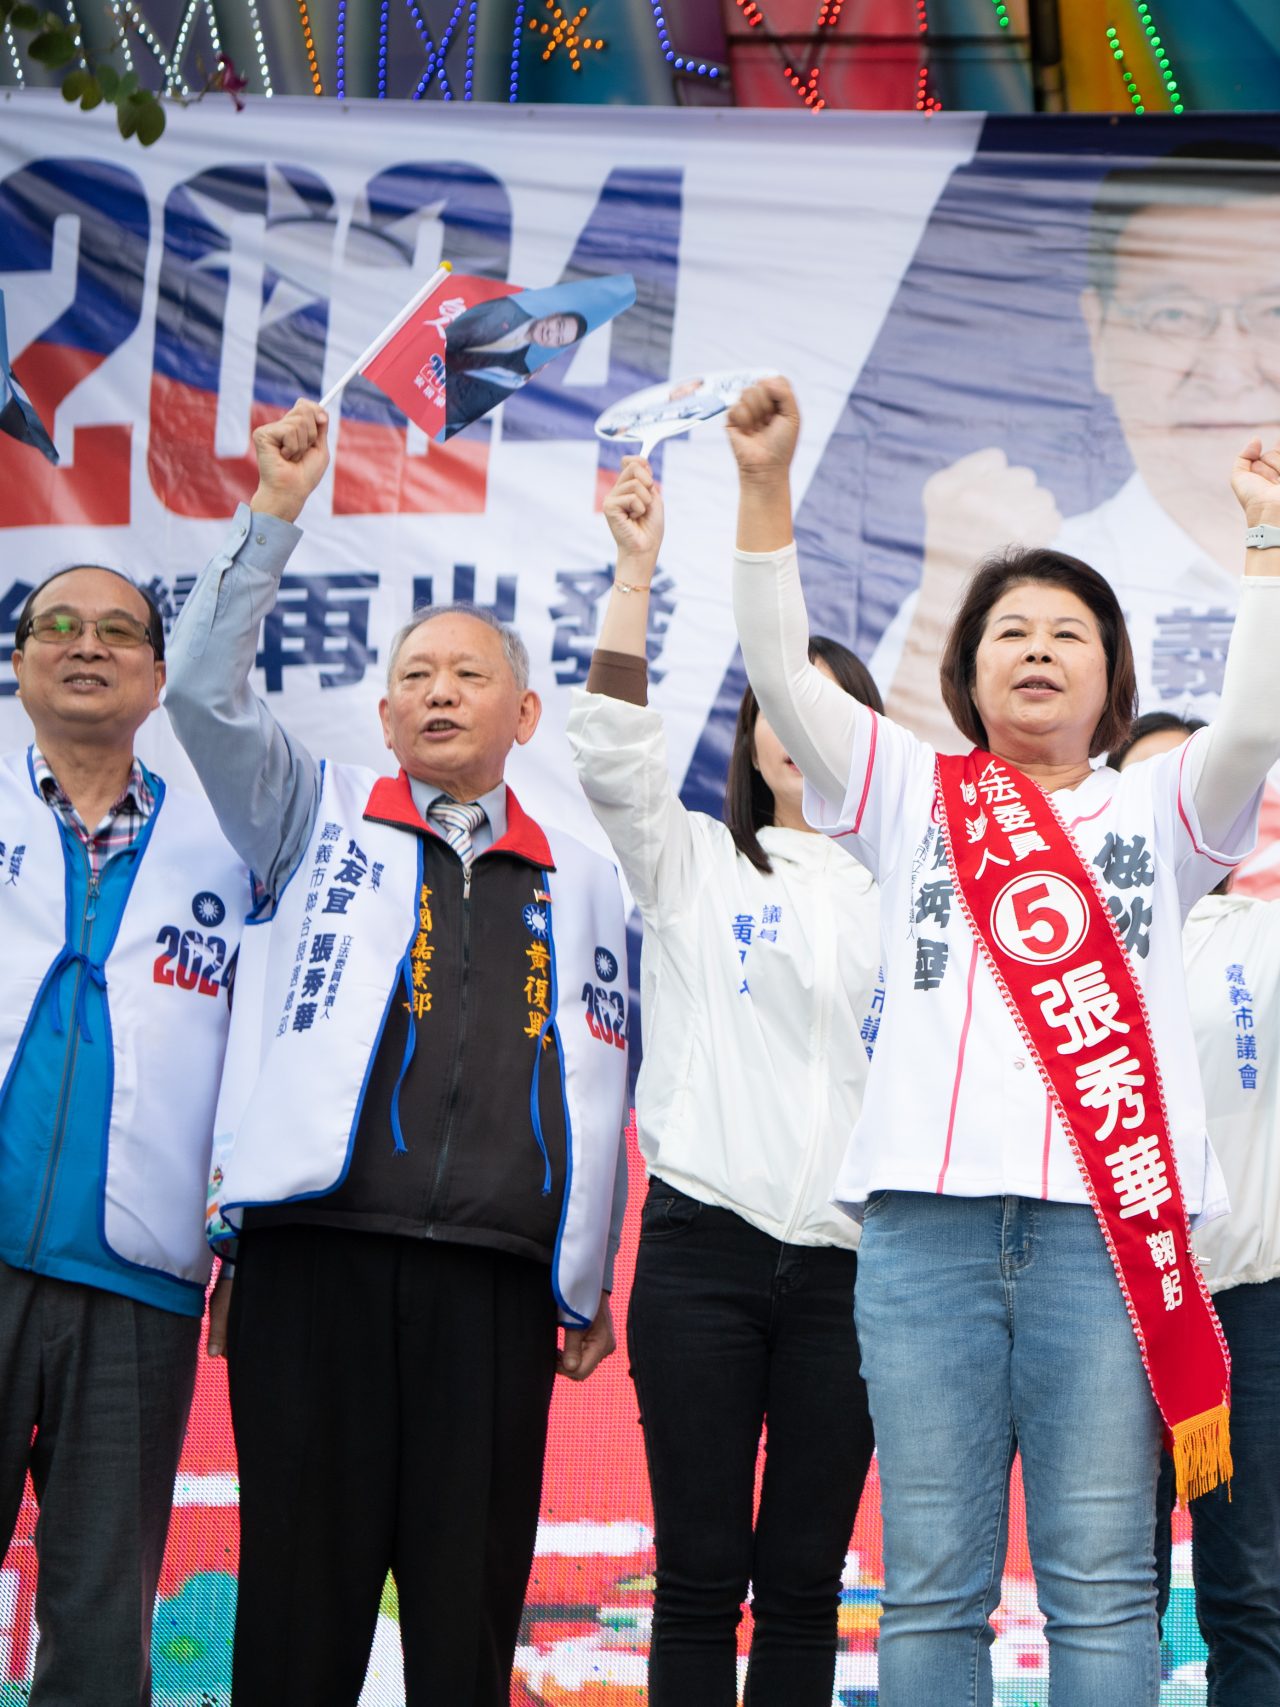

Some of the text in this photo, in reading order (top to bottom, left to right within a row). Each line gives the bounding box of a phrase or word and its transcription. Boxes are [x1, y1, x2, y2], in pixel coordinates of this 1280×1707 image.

[0, 157, 683, 526] 2024
[1009, 880, 1071, 957] 5
[292, 933, 337, 1033] 張秀華
[580, 982, 627, 1050] 202
[1225, 962, 1259, 1090] 嘉義市議會
[1030, 960, 1173, 1220] 張秀華
[1145, 1229, 1184, 1312] 鞠躬
